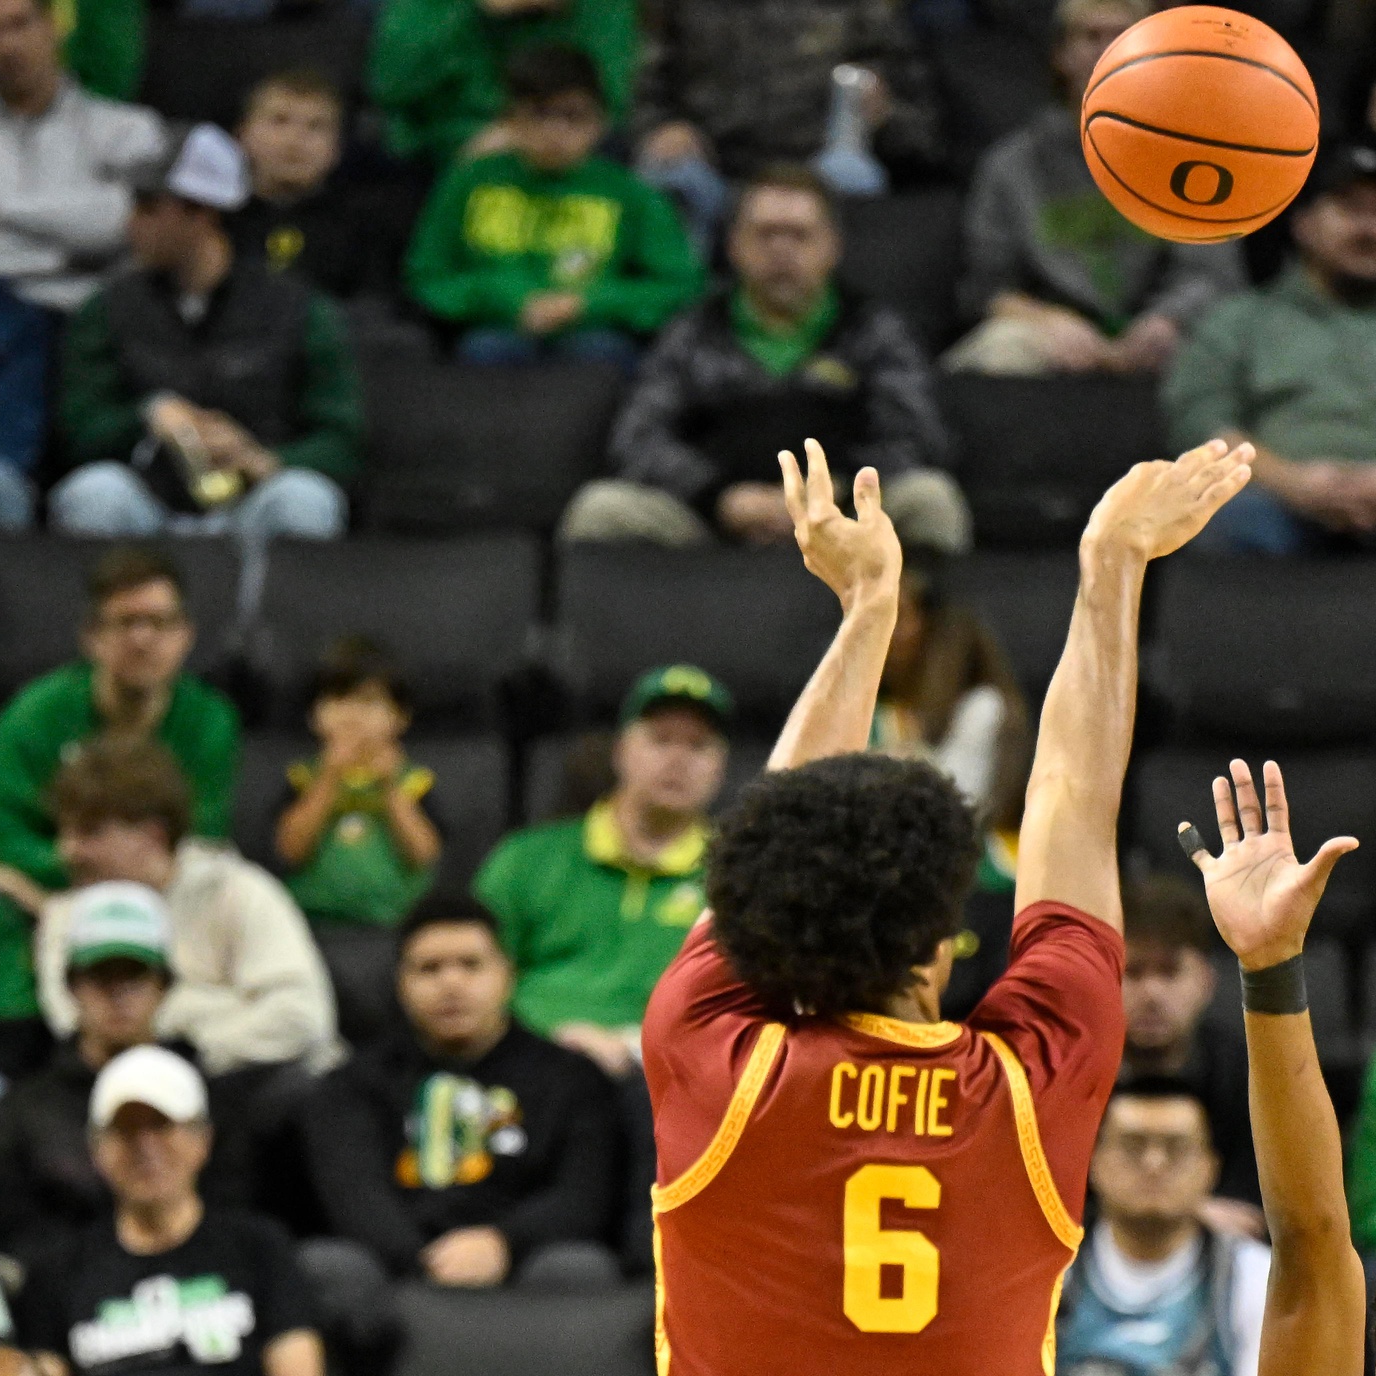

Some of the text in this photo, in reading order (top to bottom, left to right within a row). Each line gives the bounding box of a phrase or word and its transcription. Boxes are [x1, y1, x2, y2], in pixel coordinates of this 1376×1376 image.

[1169, 160, 1234, 206] O
[829, 1062, 957, 1137] COFIE
[843, 1163, 942, 1334] 6
